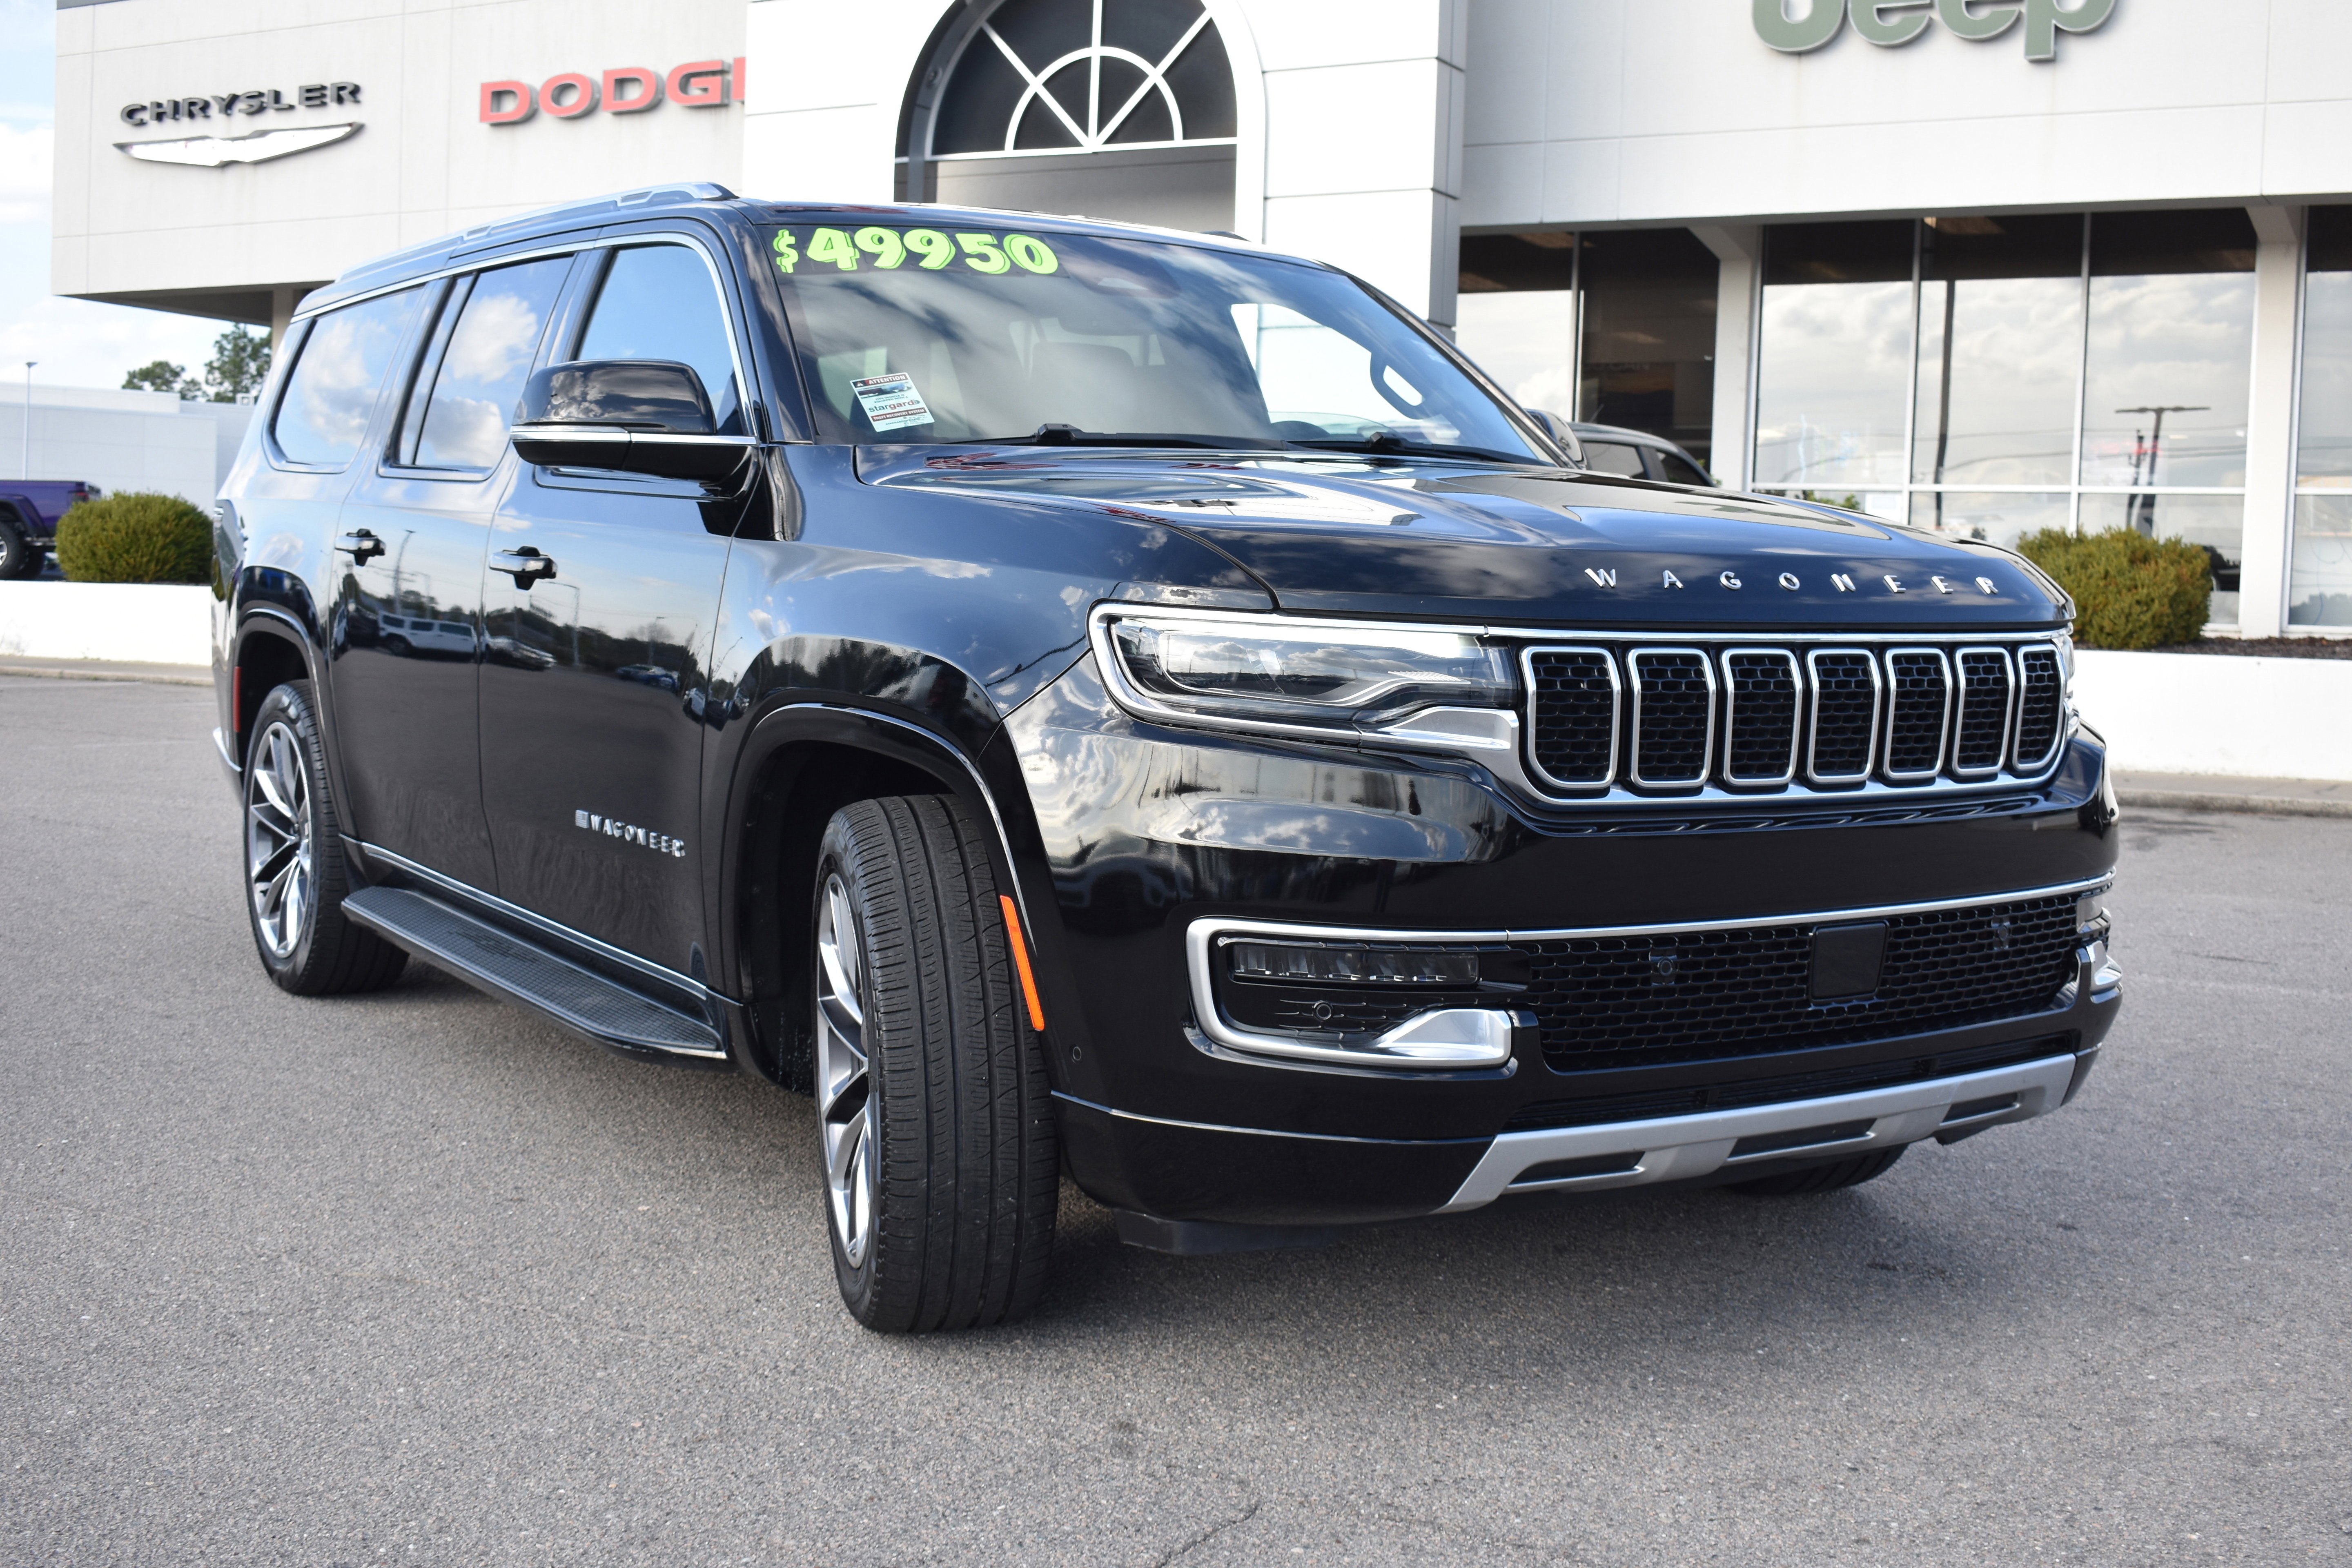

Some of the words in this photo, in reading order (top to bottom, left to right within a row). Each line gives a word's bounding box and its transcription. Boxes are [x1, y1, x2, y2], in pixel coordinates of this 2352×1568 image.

[121, 82, 361, 126] CHRYSLER
[480, 57, 746, 126] DODG
[773, 227, 1058, 274] $49950
[868, 375, 906, 385] ATTENTION
[869, 400, 915, 412] stargard
[1584, 568, 1998, 595] WAGONEER
[591, 814, 685, 857] WAGONEER
